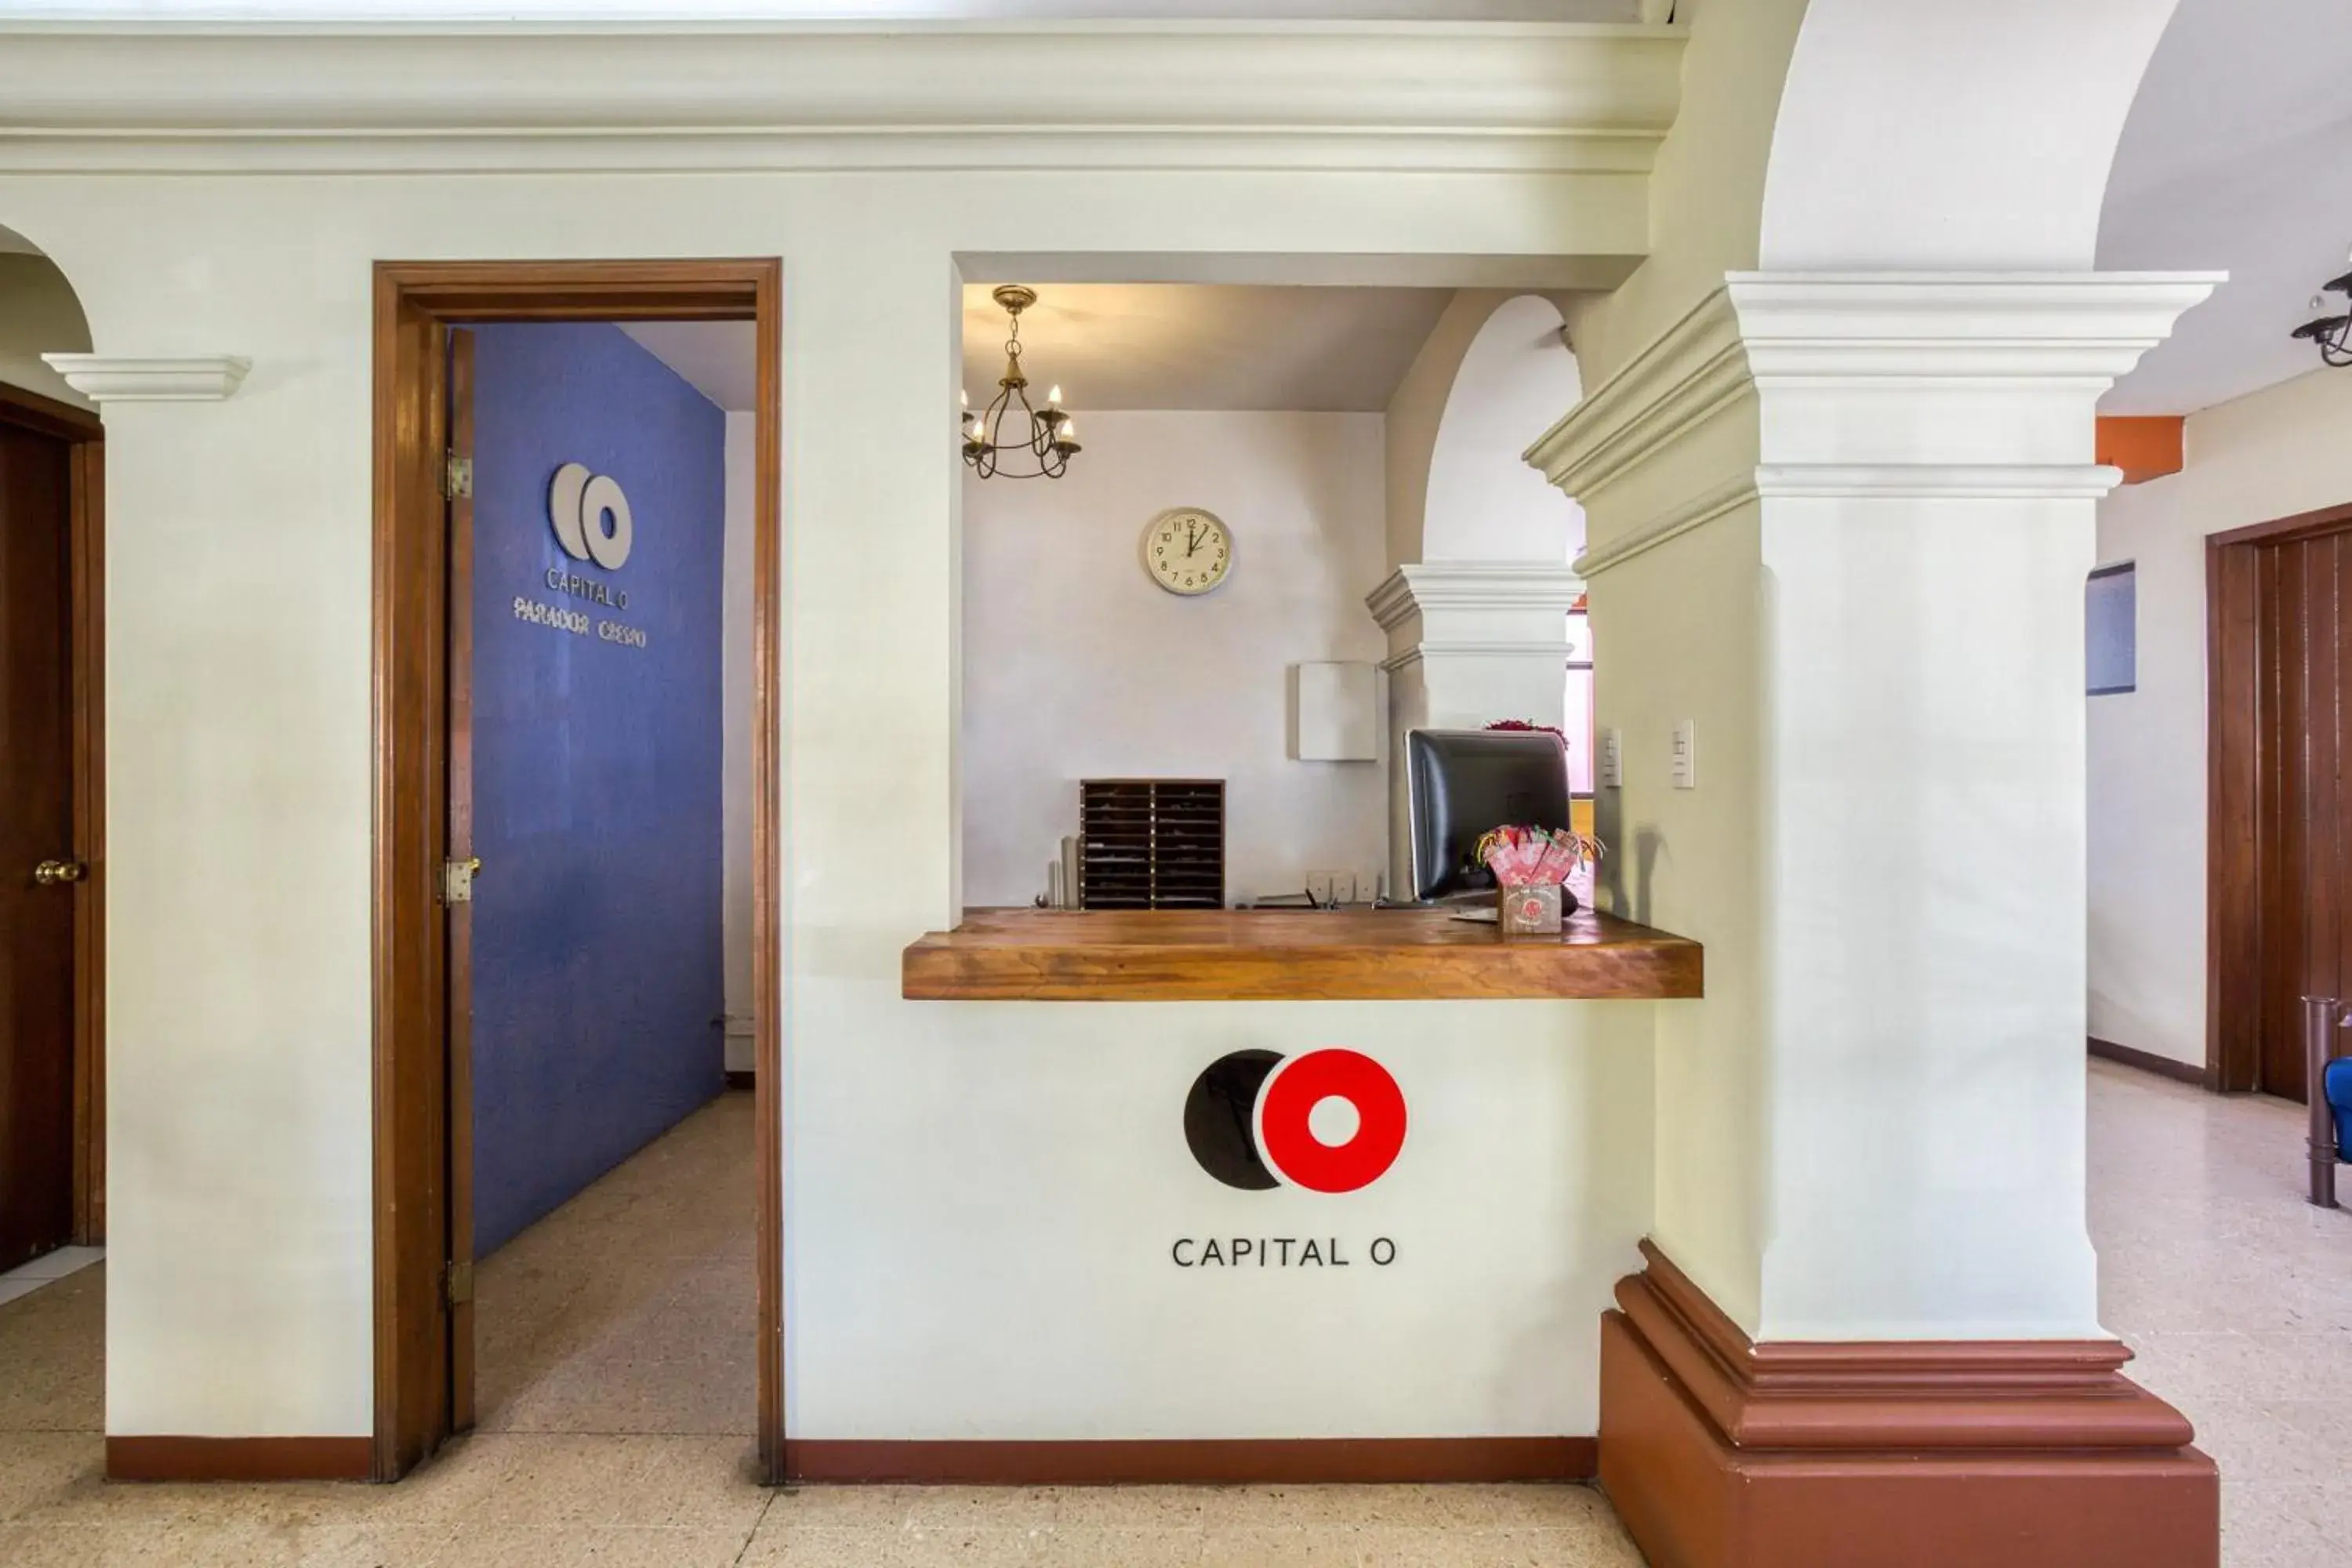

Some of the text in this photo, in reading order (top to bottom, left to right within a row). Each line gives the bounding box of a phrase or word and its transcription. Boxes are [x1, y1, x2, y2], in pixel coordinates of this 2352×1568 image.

[1173, 521, 1181, 532] 11
[1211, 532, 1220, 543] 2
[1156, 546, 1163, 557] 9
[1217, 548, 1224, 559] 3
[1161, 561, 1167, 571] 8
[1211, 562, 1218, 572] 4
[1172, 572, 1178, 582] 7
[1185, 576, 1193, 586] 6
[546, 568, 629, 611] CAPITAL O
[514, 597, 590, 636] PARADOR
[1172, 1237, 1396, 1267] CAPITAL O
